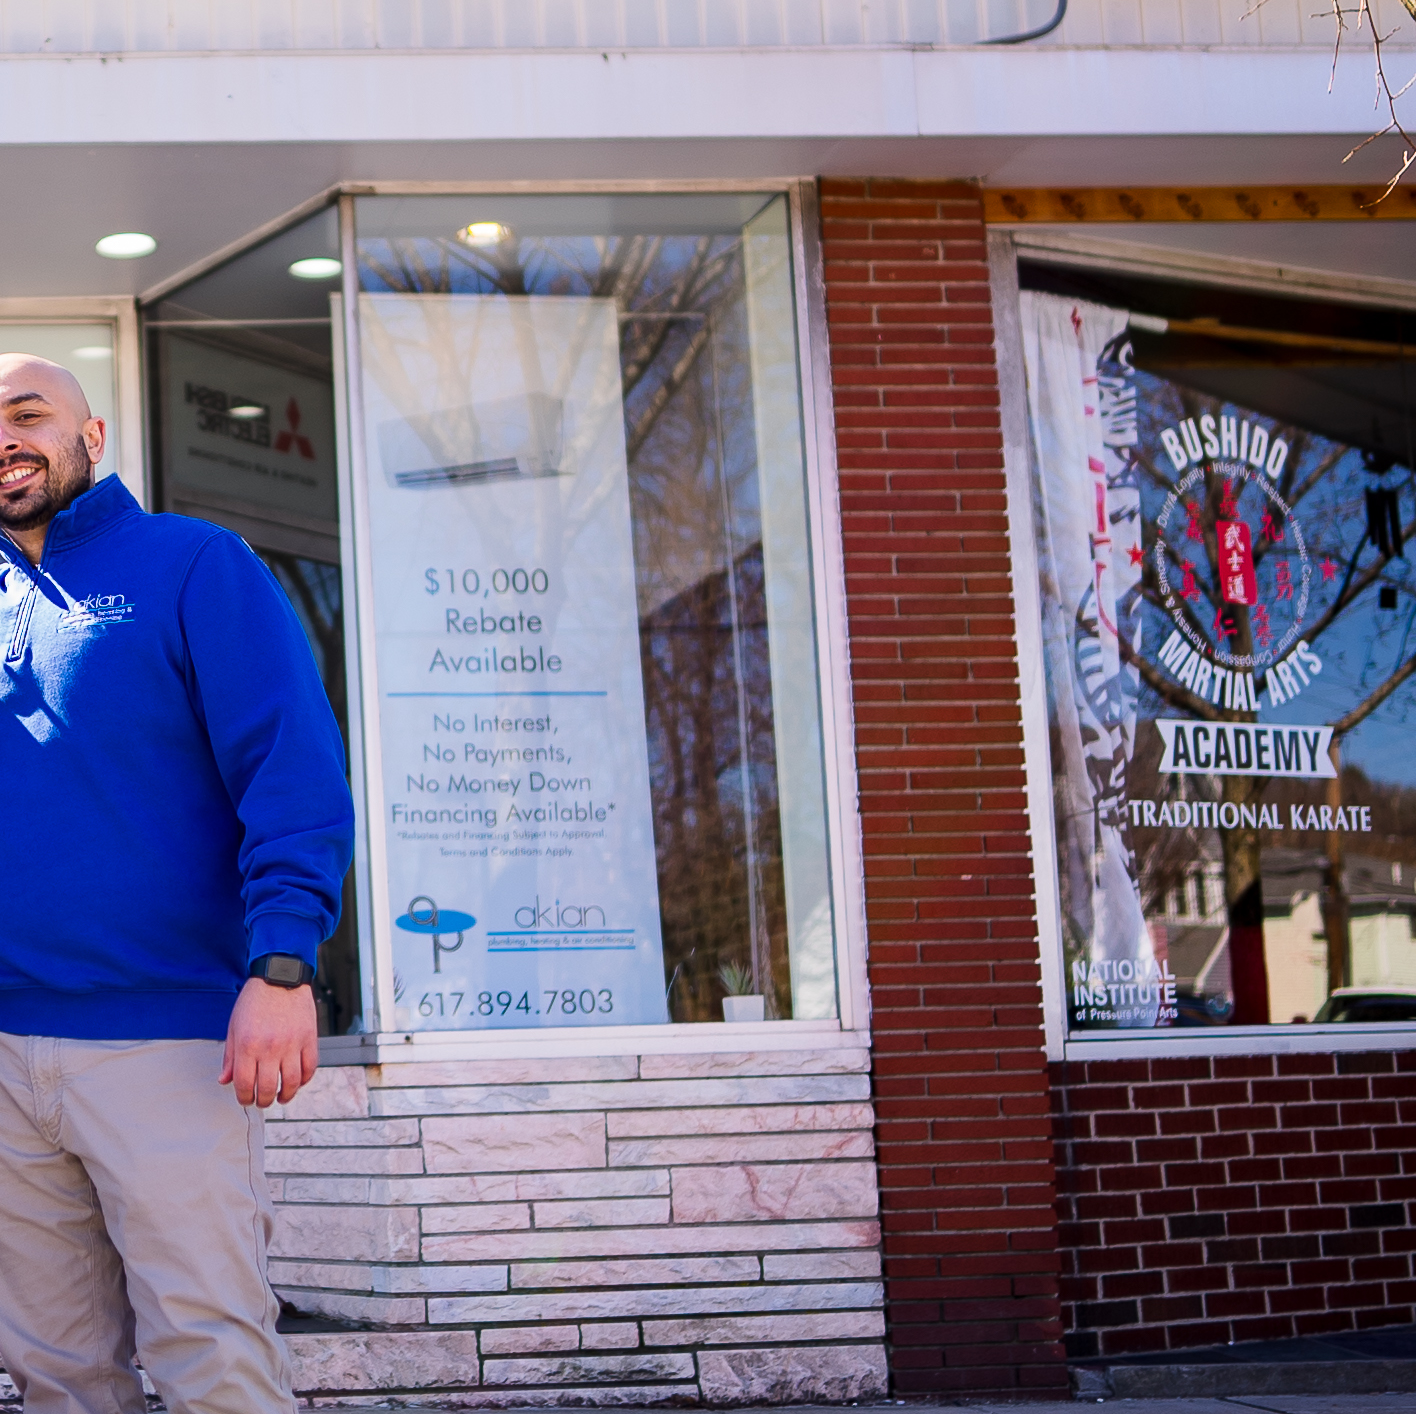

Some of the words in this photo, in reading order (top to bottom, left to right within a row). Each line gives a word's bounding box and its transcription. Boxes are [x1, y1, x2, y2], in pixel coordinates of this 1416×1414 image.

[1160, 414, 1288, 479] BUSHIDO
[1212, 461, 1251, 481] Integrity
[1256, 474, 1291, 517] Respect
[424, 567, 549, 599] $10,000
[445, 607, 542, 634] Rebate
[429, 645, 562, 674] Available
[1158, 629, 1262, 711] MARTIAL
[1265, 639, 1323, 708] ARTS
[433, 713, 465, 733] No
[474, 714, 559, 735] Interest,
[423, 743, 456, 763] No
[464, 743, 572, 767] Payments,
[1172, 725, 1321, 772] ACADEMY
[406, 773, 439, 793] No
[447, 774, 521, 796] Money
[529, 771, 591, 792] Down
[392, 803, 497, 828] Financing
[1128, 799, 1284, 831] TRADITIONAL
[1290, 803, 1372, 832] KARATE
[469, 847, 488, 857] and
[491, 846, 542, 857] Conditions
[514, 894, 606, 929] akian
[1072, 959, 1176, 981] NATIONAL
[418, 989, 614, 1017] 617.894.7803
[1073, 982, 1178, 1006] INSTITUTE
[1075, 1008, 1086, 1021] of
[1090, 1007, 1132, 1020] Pressure
[1159, 1006, 1179, 1019] Arts
